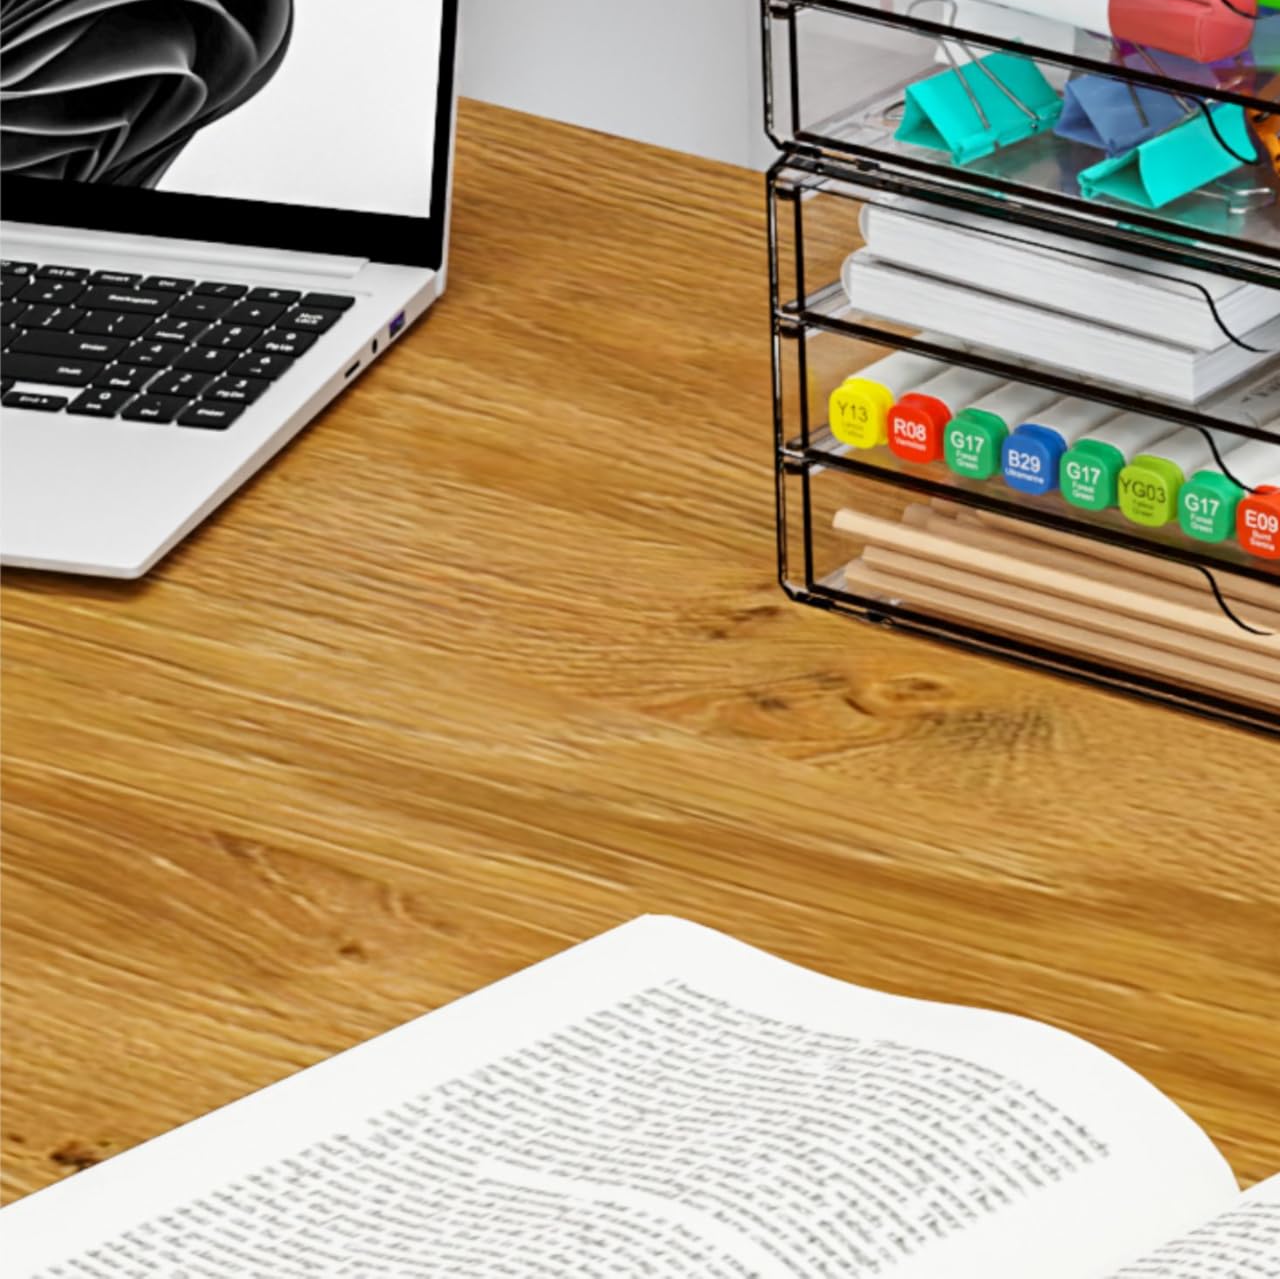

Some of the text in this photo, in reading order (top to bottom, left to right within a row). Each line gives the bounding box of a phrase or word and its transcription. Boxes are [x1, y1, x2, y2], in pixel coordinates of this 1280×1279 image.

[836, 400, 869, 423] Y13
[893, 417, 927, 442] R08
[950, 431, 984, 453] G17
[1008, 449, 1041, 473] B29
[1066, 462, 1101, 486] G17
[1120, 476, 1166, 504] YG03
[1184, 493, 1220, 517] G17
[1244, 509, 1279, 533] E09
